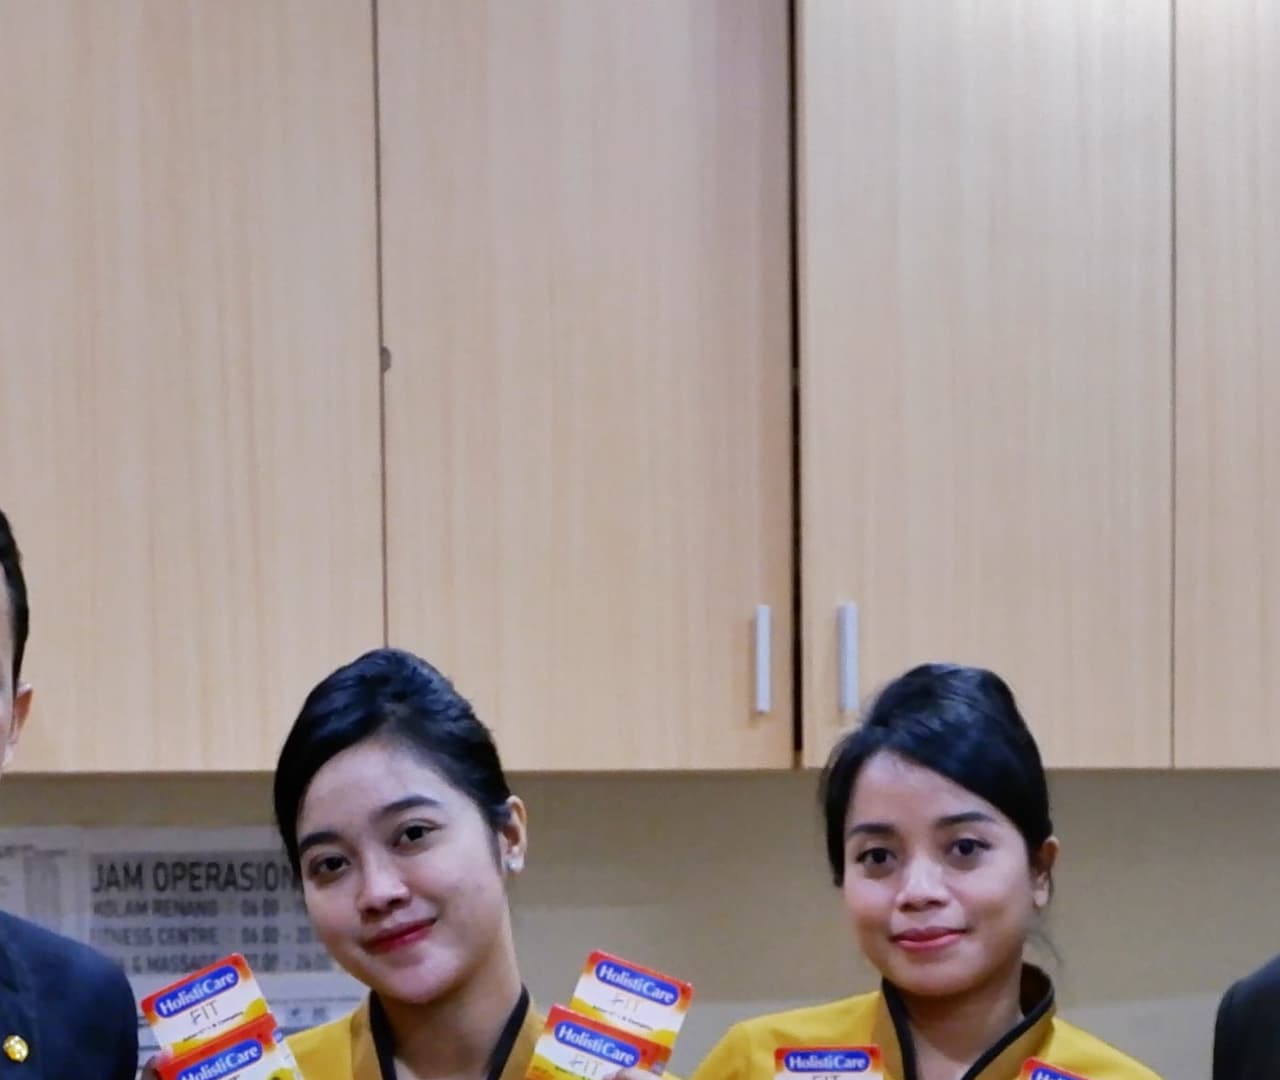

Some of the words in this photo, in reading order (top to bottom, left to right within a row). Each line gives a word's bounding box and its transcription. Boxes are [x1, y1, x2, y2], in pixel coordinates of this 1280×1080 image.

[92, 862, 144, 893] JAM
[159, 972, 236, 1016] HolistiCare
[599, 964, 675, 1003] HolistiCare
[190, 1000, 220, 1026] FIT
[559, 1025, 635, 1065] HolistiCare
[571, 1054, 603, 1076] FIT
[789, 1055, 867, 1069] HolistiCare
